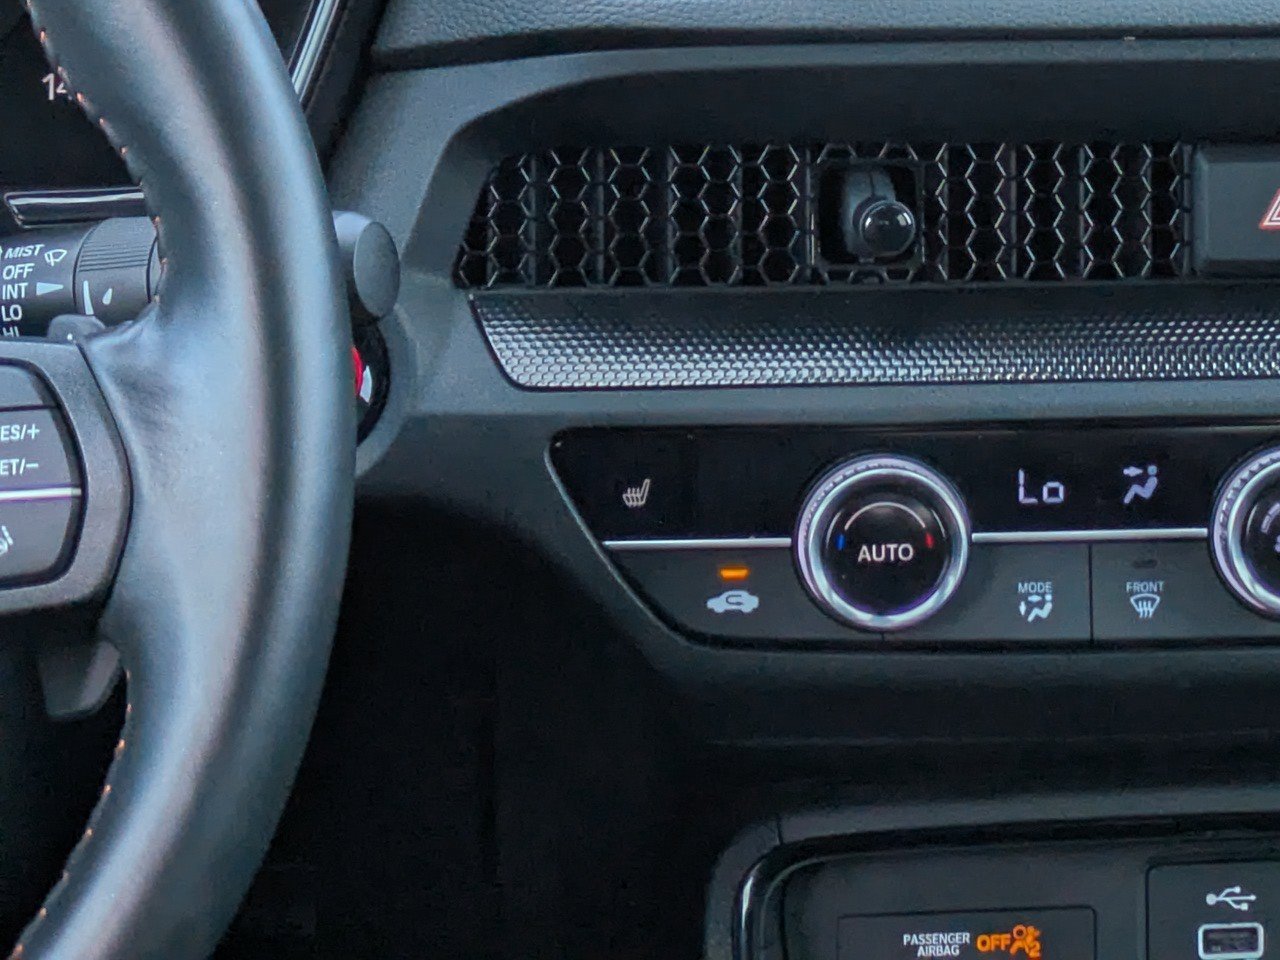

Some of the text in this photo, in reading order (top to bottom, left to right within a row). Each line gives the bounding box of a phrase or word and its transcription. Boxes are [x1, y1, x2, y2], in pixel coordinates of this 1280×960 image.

[4, 243, 45, 259] MIST
[2, 262, 35, 281] OFF
[1, 282, 29, 301] INT
[1, 303, 23, 322] LO
[1018, 468, 1065, 504] Lo
[857, 542, 915, 563] AUTO
[1017, 581, 1053, 594] MODE
[1125, 580, 1165, 593] FRONT
[902, 931, 971, 946] PASSENGER
[976, 933, 1011, 952] OFF
[916, 944, 961, 958] AIRBAG
